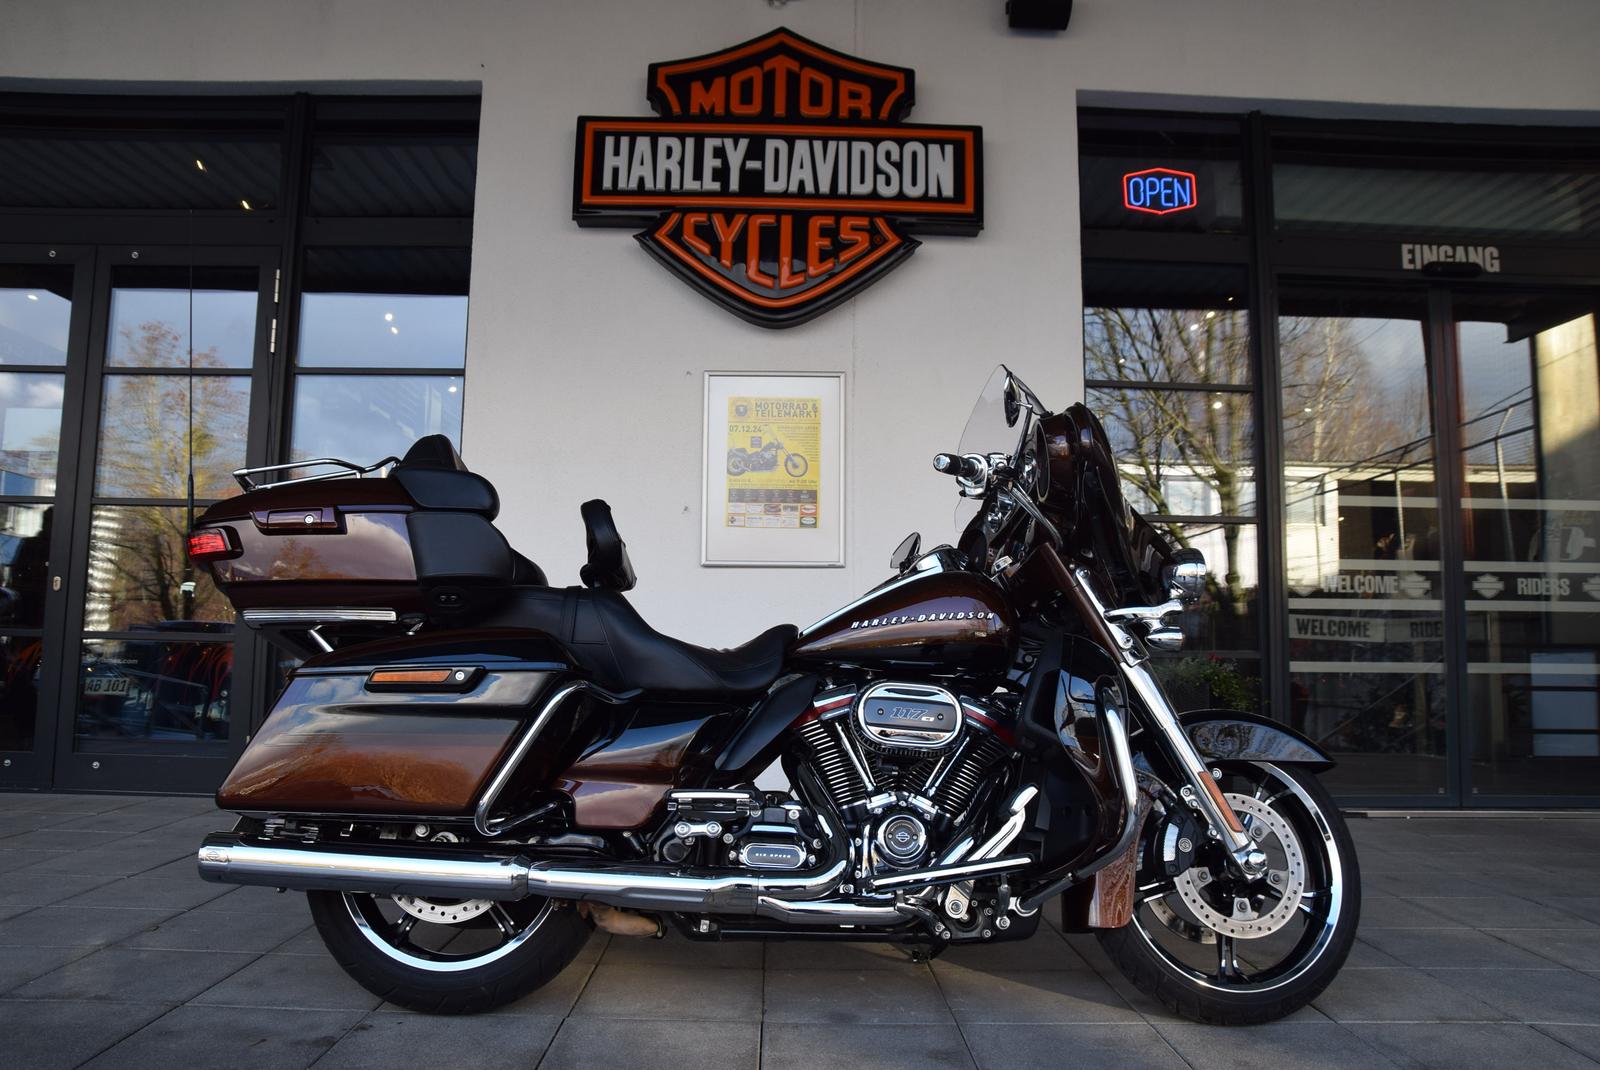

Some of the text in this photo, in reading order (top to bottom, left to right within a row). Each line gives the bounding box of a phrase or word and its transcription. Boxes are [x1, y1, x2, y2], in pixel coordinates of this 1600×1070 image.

[689, 54, 873, 120] MOTOR
[601, 135, 955, 199] HARLEY-DAVIDSON
[1129, 177, 1191, 207] OPEN
[682, 211, 872, 290] CYCLES
[1401, 243, 1500, 272] EINGANG
[755, 402, 808, 410] MOTORRAD
[755, 410, 818, 418] TEILEMARKT
[1323, 575, 1570, 596] WELCOME RIDERS
[1295, 618, 1444, 639] WELCOME RIDE
[103, 679, 127, 692] 101
[890, 707, 928, 720] 117
